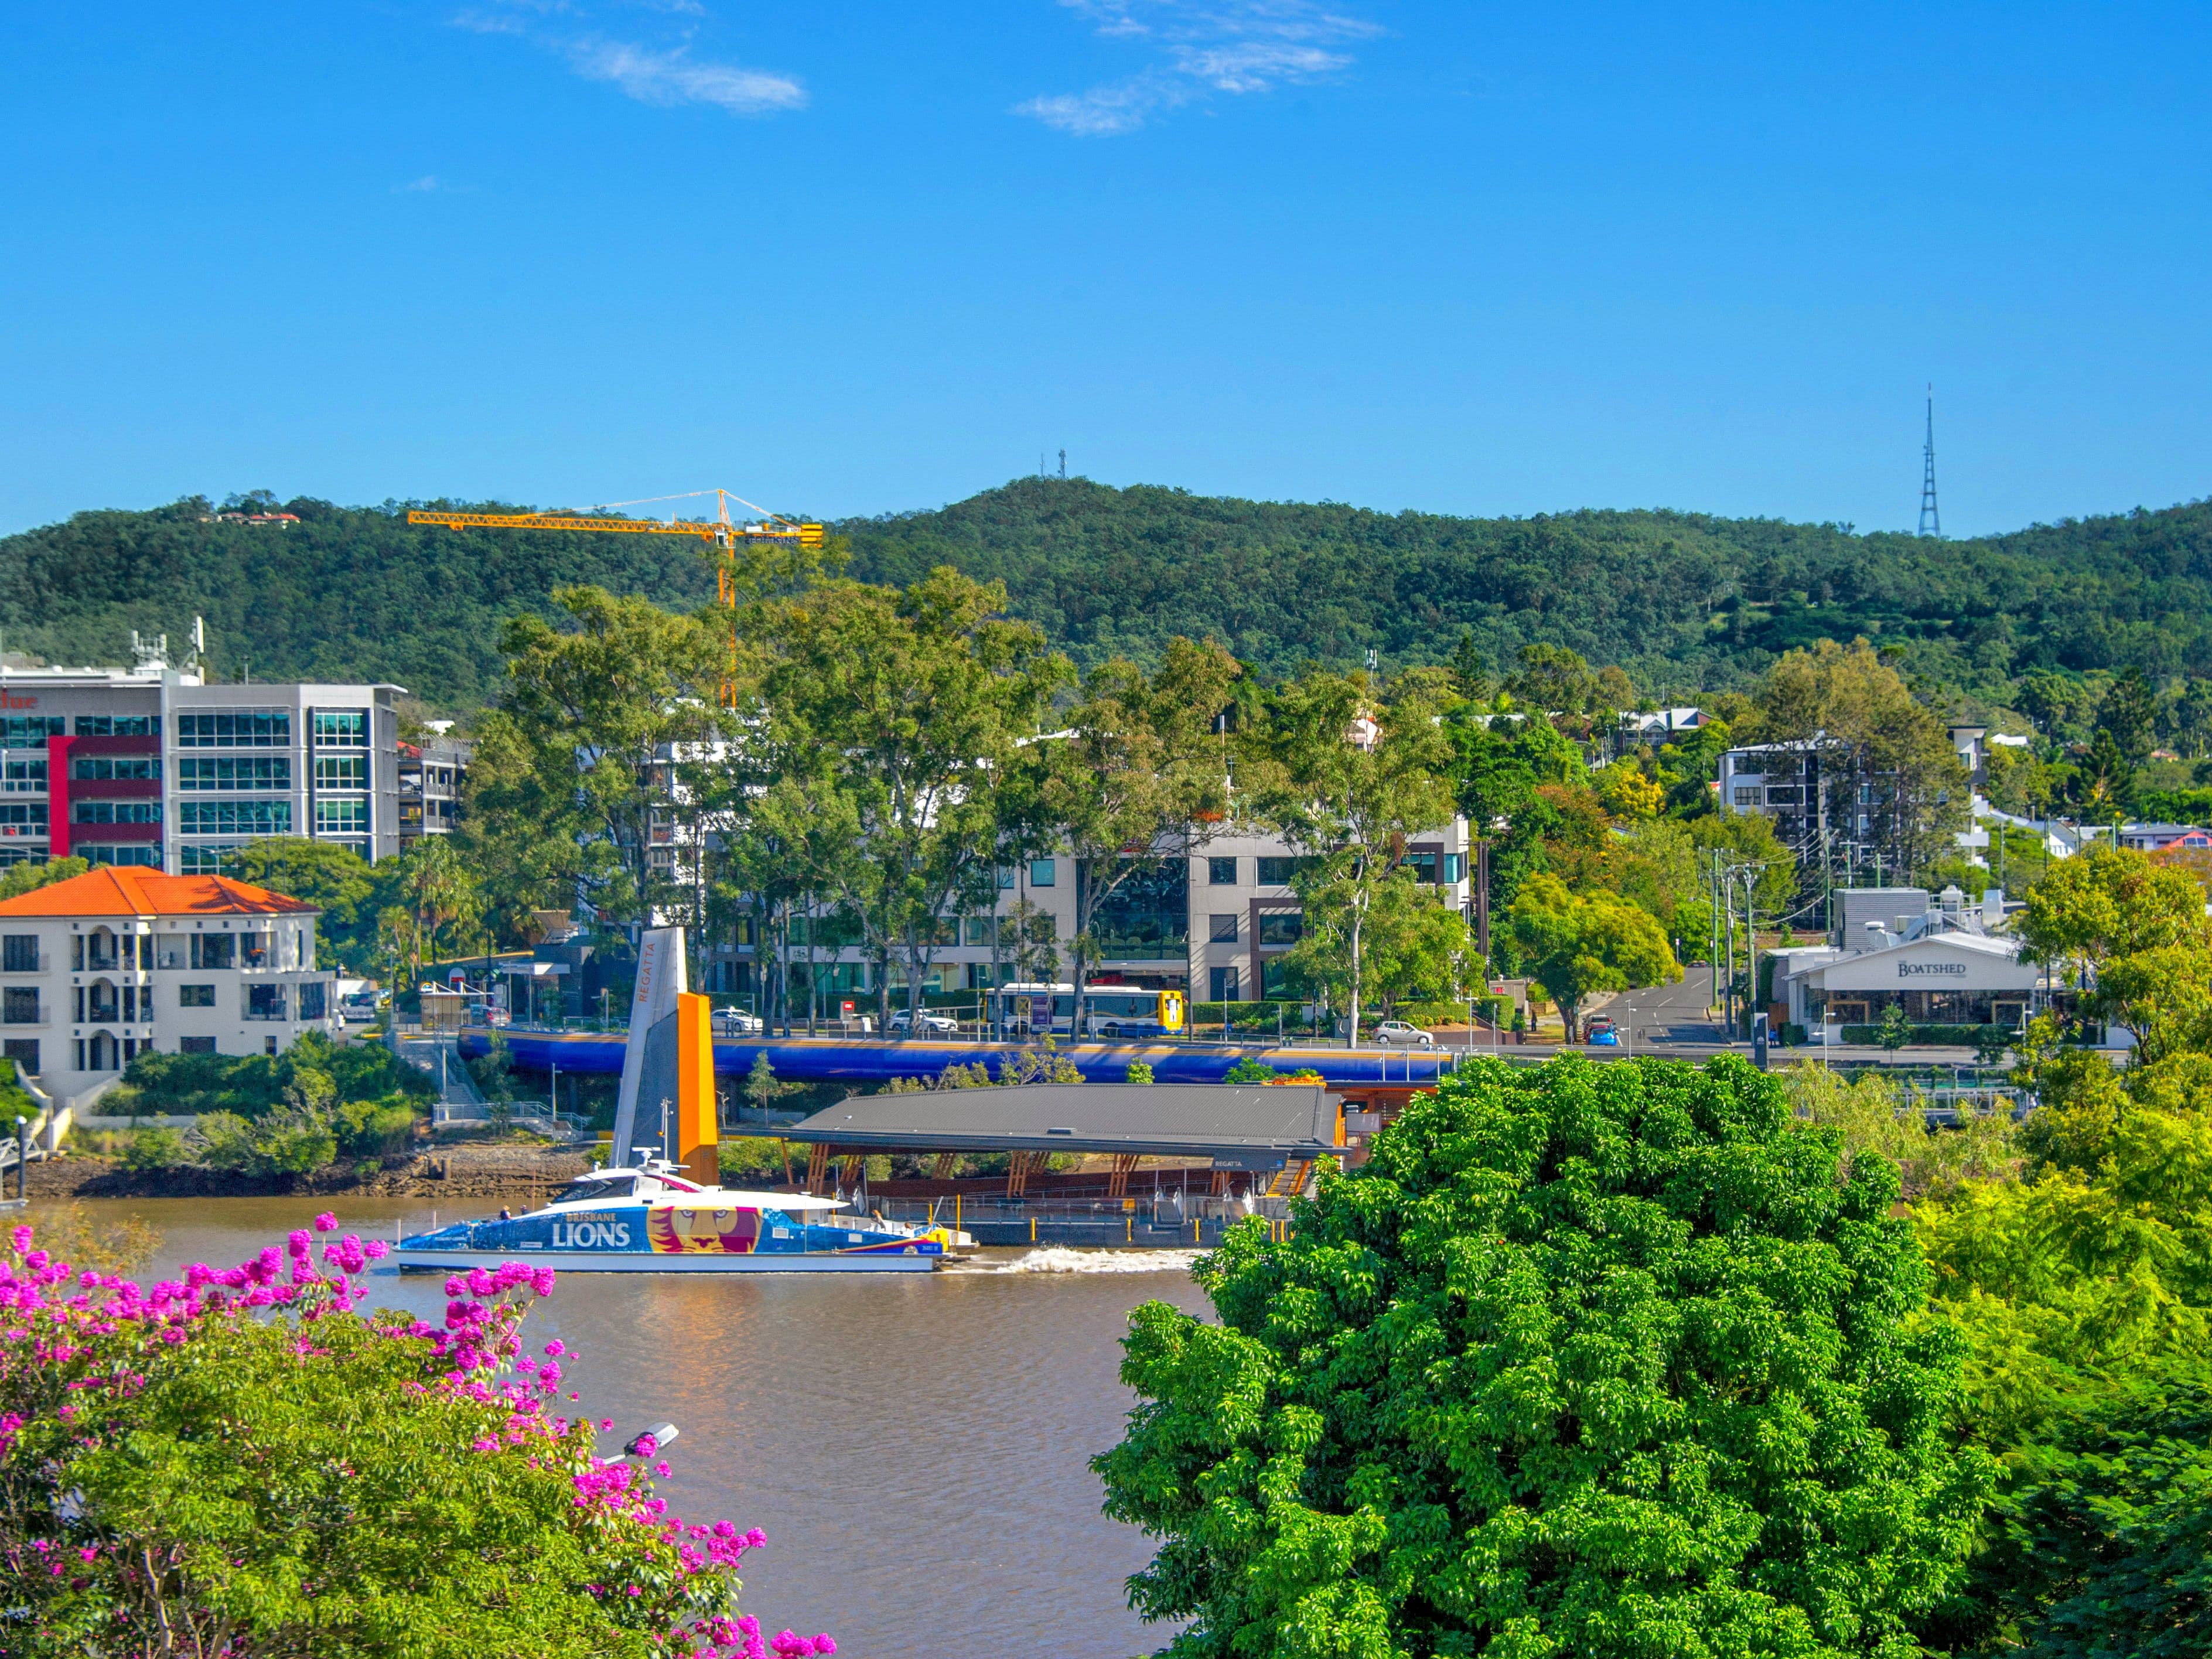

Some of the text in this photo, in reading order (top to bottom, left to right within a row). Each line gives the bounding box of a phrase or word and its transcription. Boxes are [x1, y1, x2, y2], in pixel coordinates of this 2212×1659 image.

[638, 943, 656, 1002] REGATTA
[1898, 964, 1967, 977] BOATSHED
[566, 1213, 617, 1222] BRISBANE
[552, 1222, 630, 1247] LIONS
